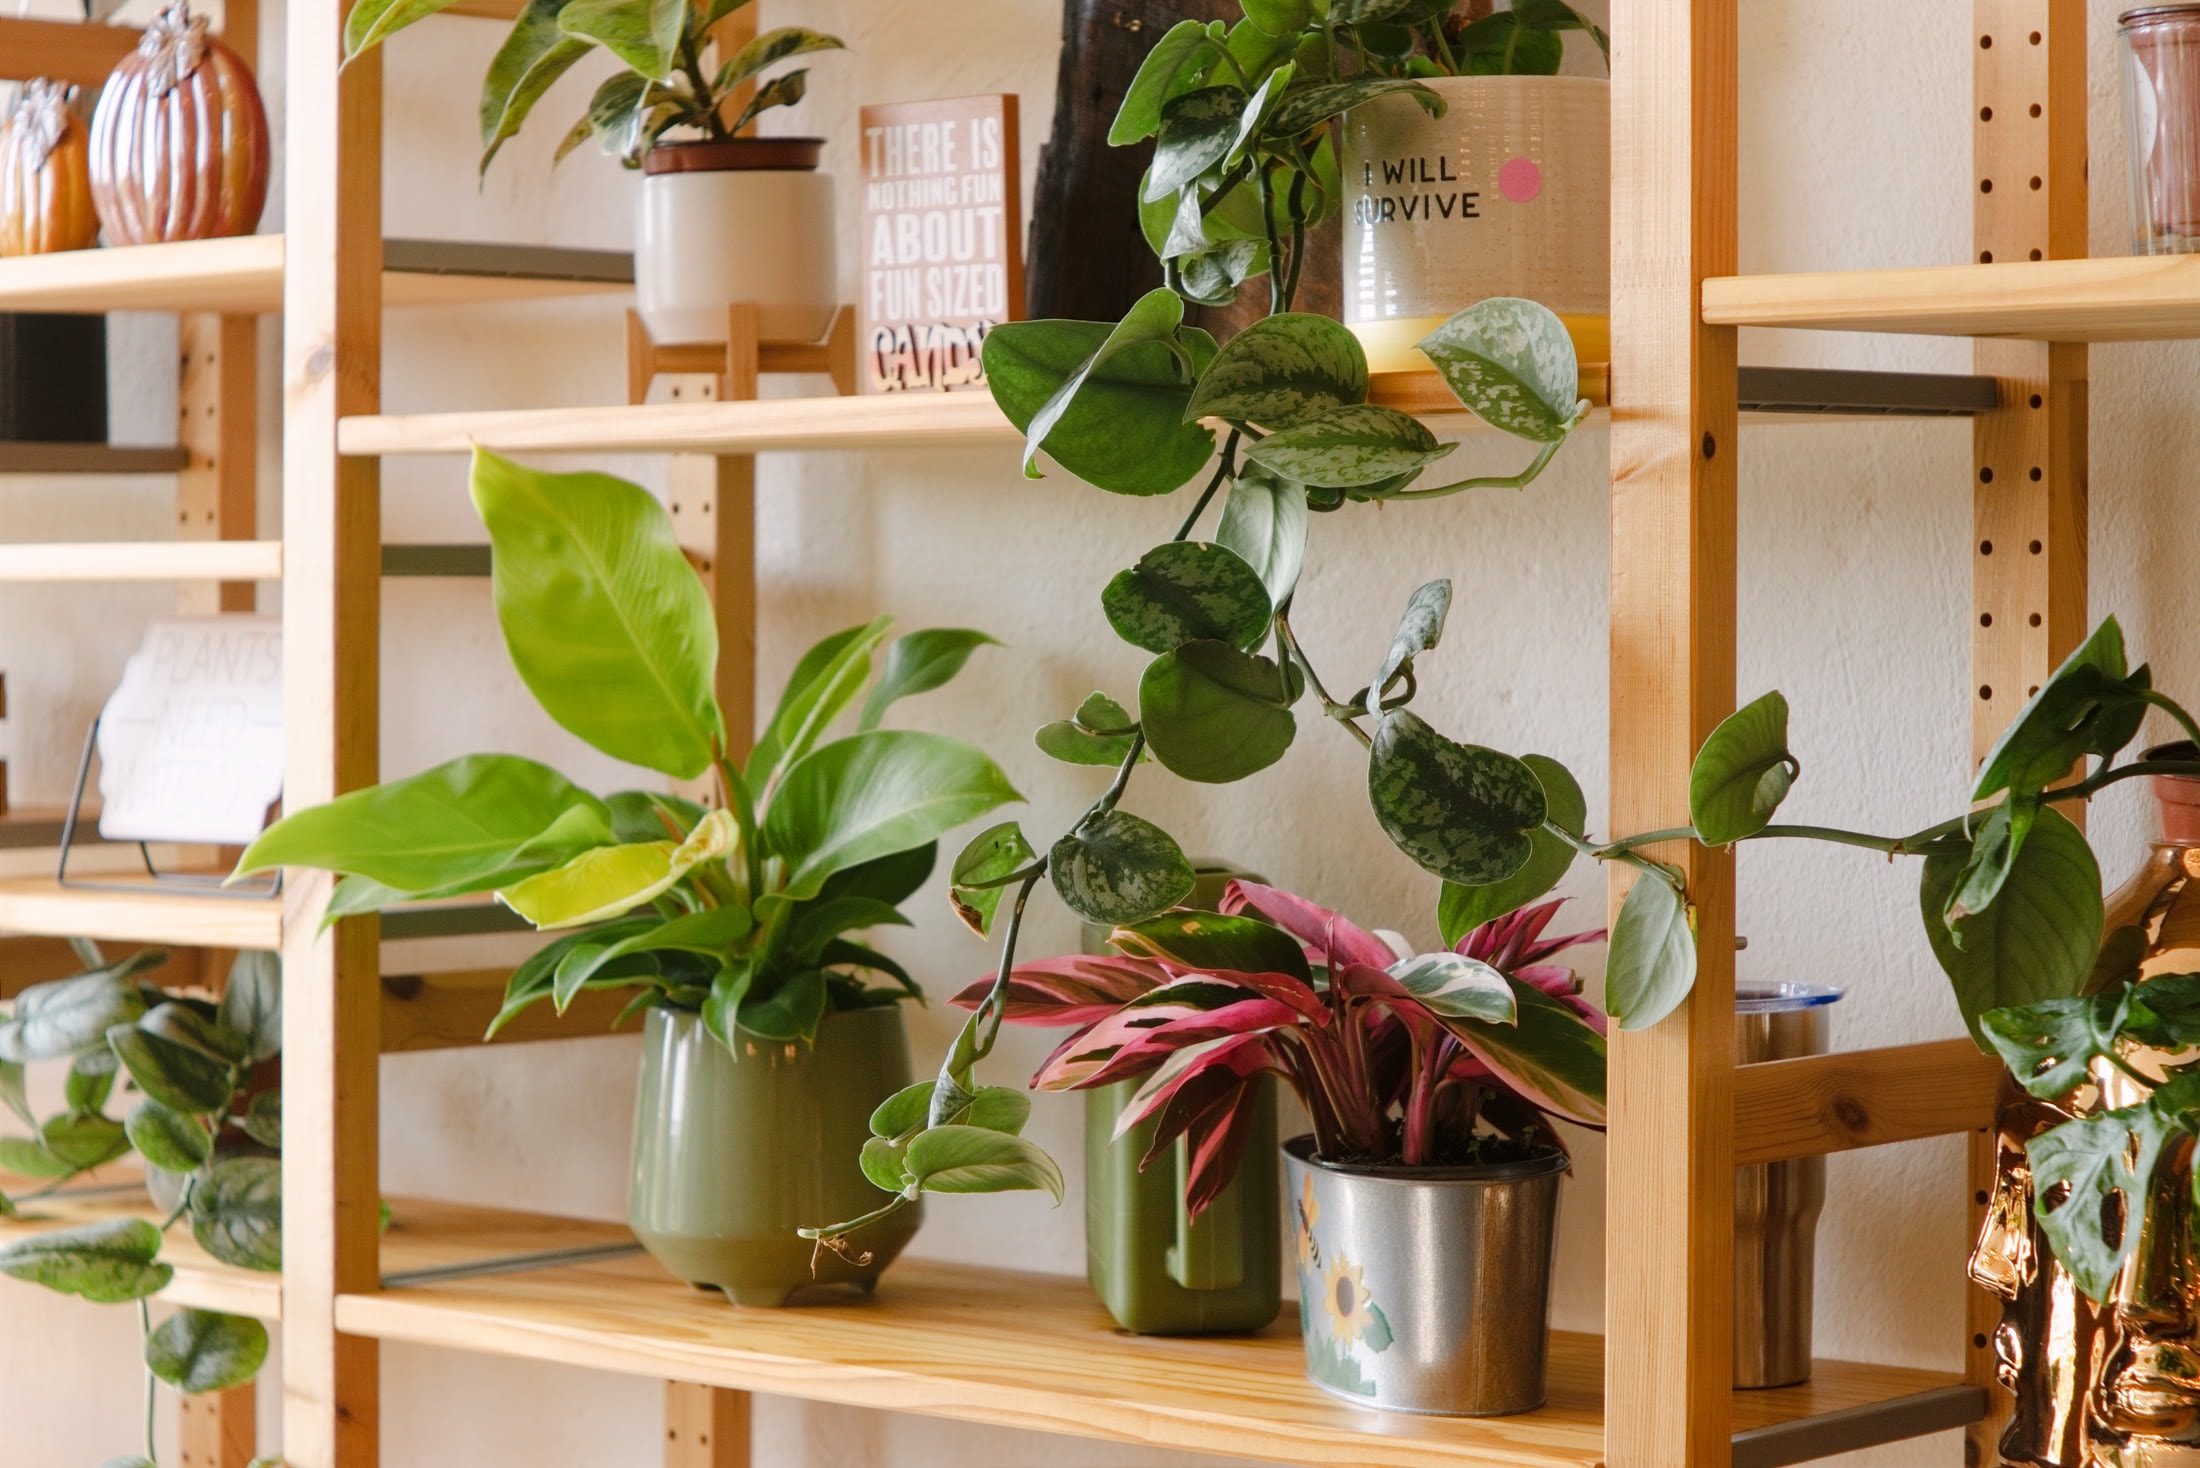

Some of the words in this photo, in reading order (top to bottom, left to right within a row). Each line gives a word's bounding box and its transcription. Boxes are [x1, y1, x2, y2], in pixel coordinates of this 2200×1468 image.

[865, 121, 957, 177] THERE
[970, 117, 1000, 170] IS
[867, 178, 957, 211] NOTHING
[961, 173, 1001, 206] FUN
[1364, 161, 1371, 188] I
[1382, 156, 1457, 184] WILL
[1354, 192, 1481, 226] SURVIVE
[871, 207, 1002, 266] ABOUT
[869, 268, 921, 322] FUN
[926, 264, 1002, 319] SIZED
